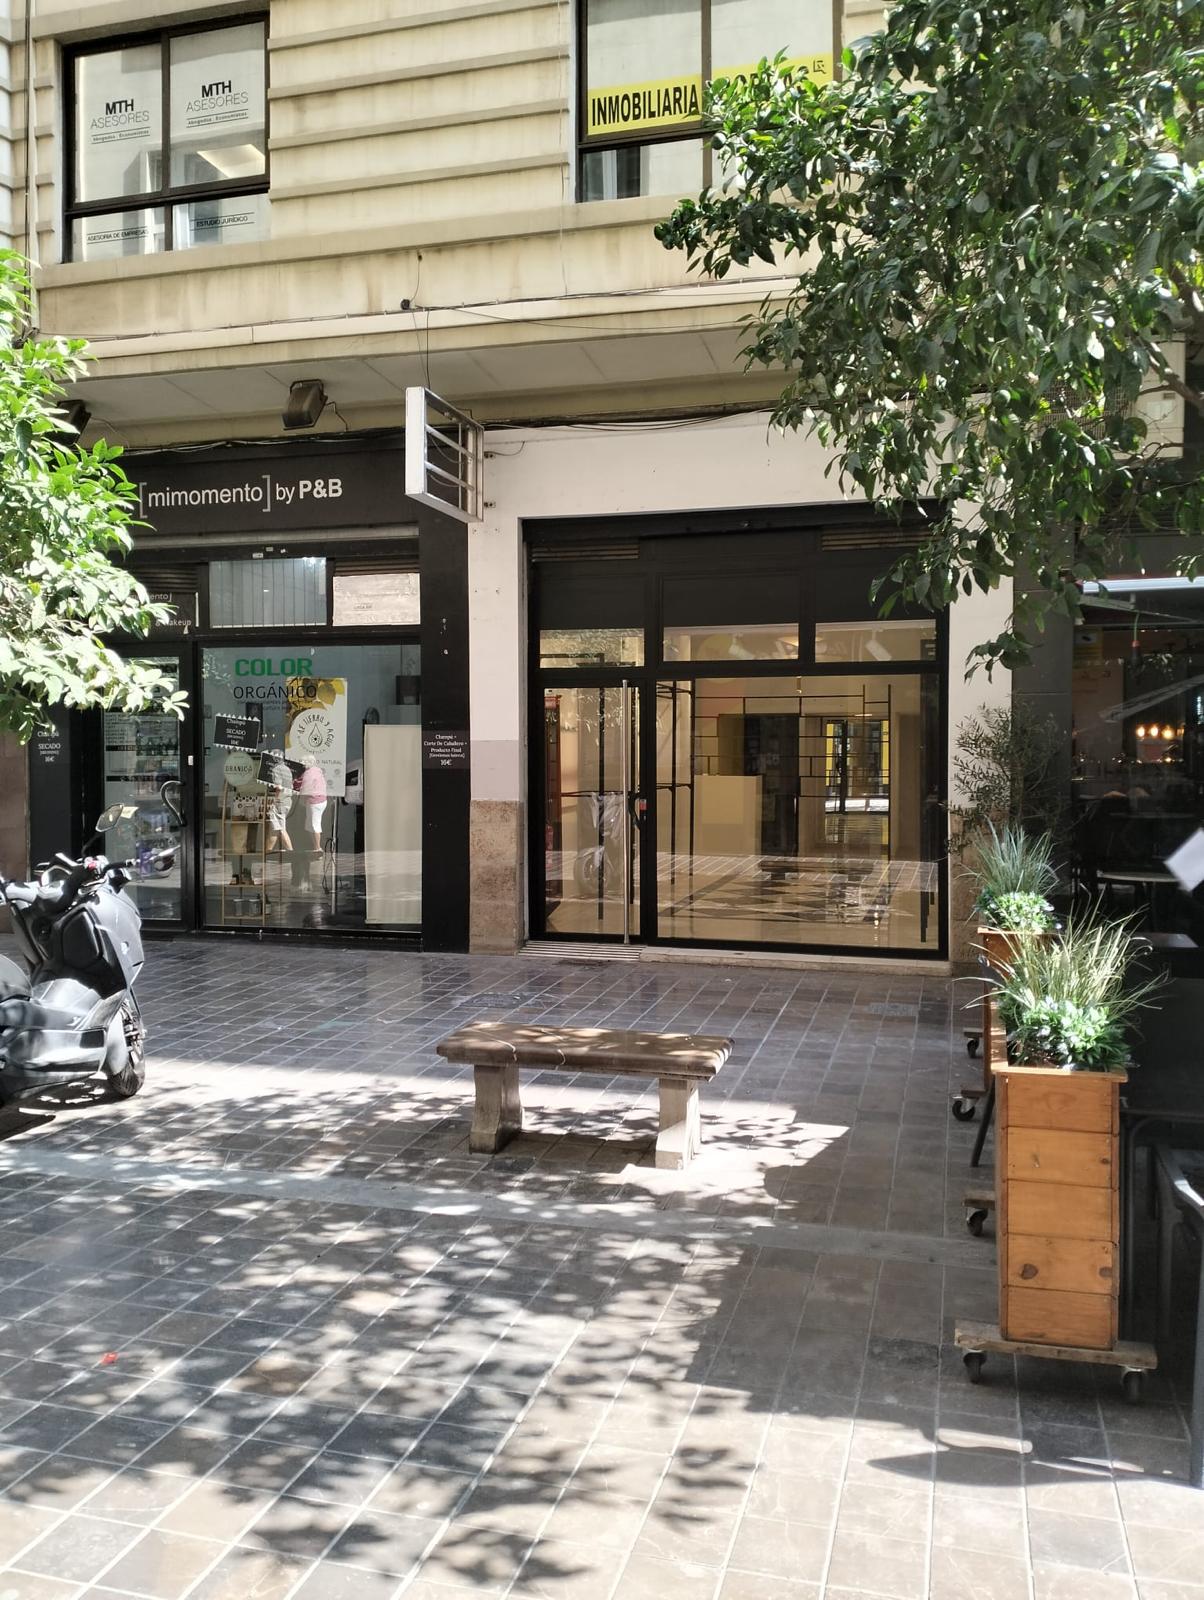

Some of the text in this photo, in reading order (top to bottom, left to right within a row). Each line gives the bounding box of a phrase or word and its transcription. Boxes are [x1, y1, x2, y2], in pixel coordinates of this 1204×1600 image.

[202, 79, 232, 98] MTH
[106, 98, 134, 115] MTH
[186, 91, 249, 112] ASESORES
[592, 84, 700, 126] INMOBILIARIA
[91, 110, 150, 129] ASESORES
[196, 219, 220, 228] ESTUDIO
[275, 482, 295, 504] by
[299, 478, 343, 499] P&B
[235, 658, 313, 676] COLOR
[233, 681, 317, 699] ORGÁNICO
